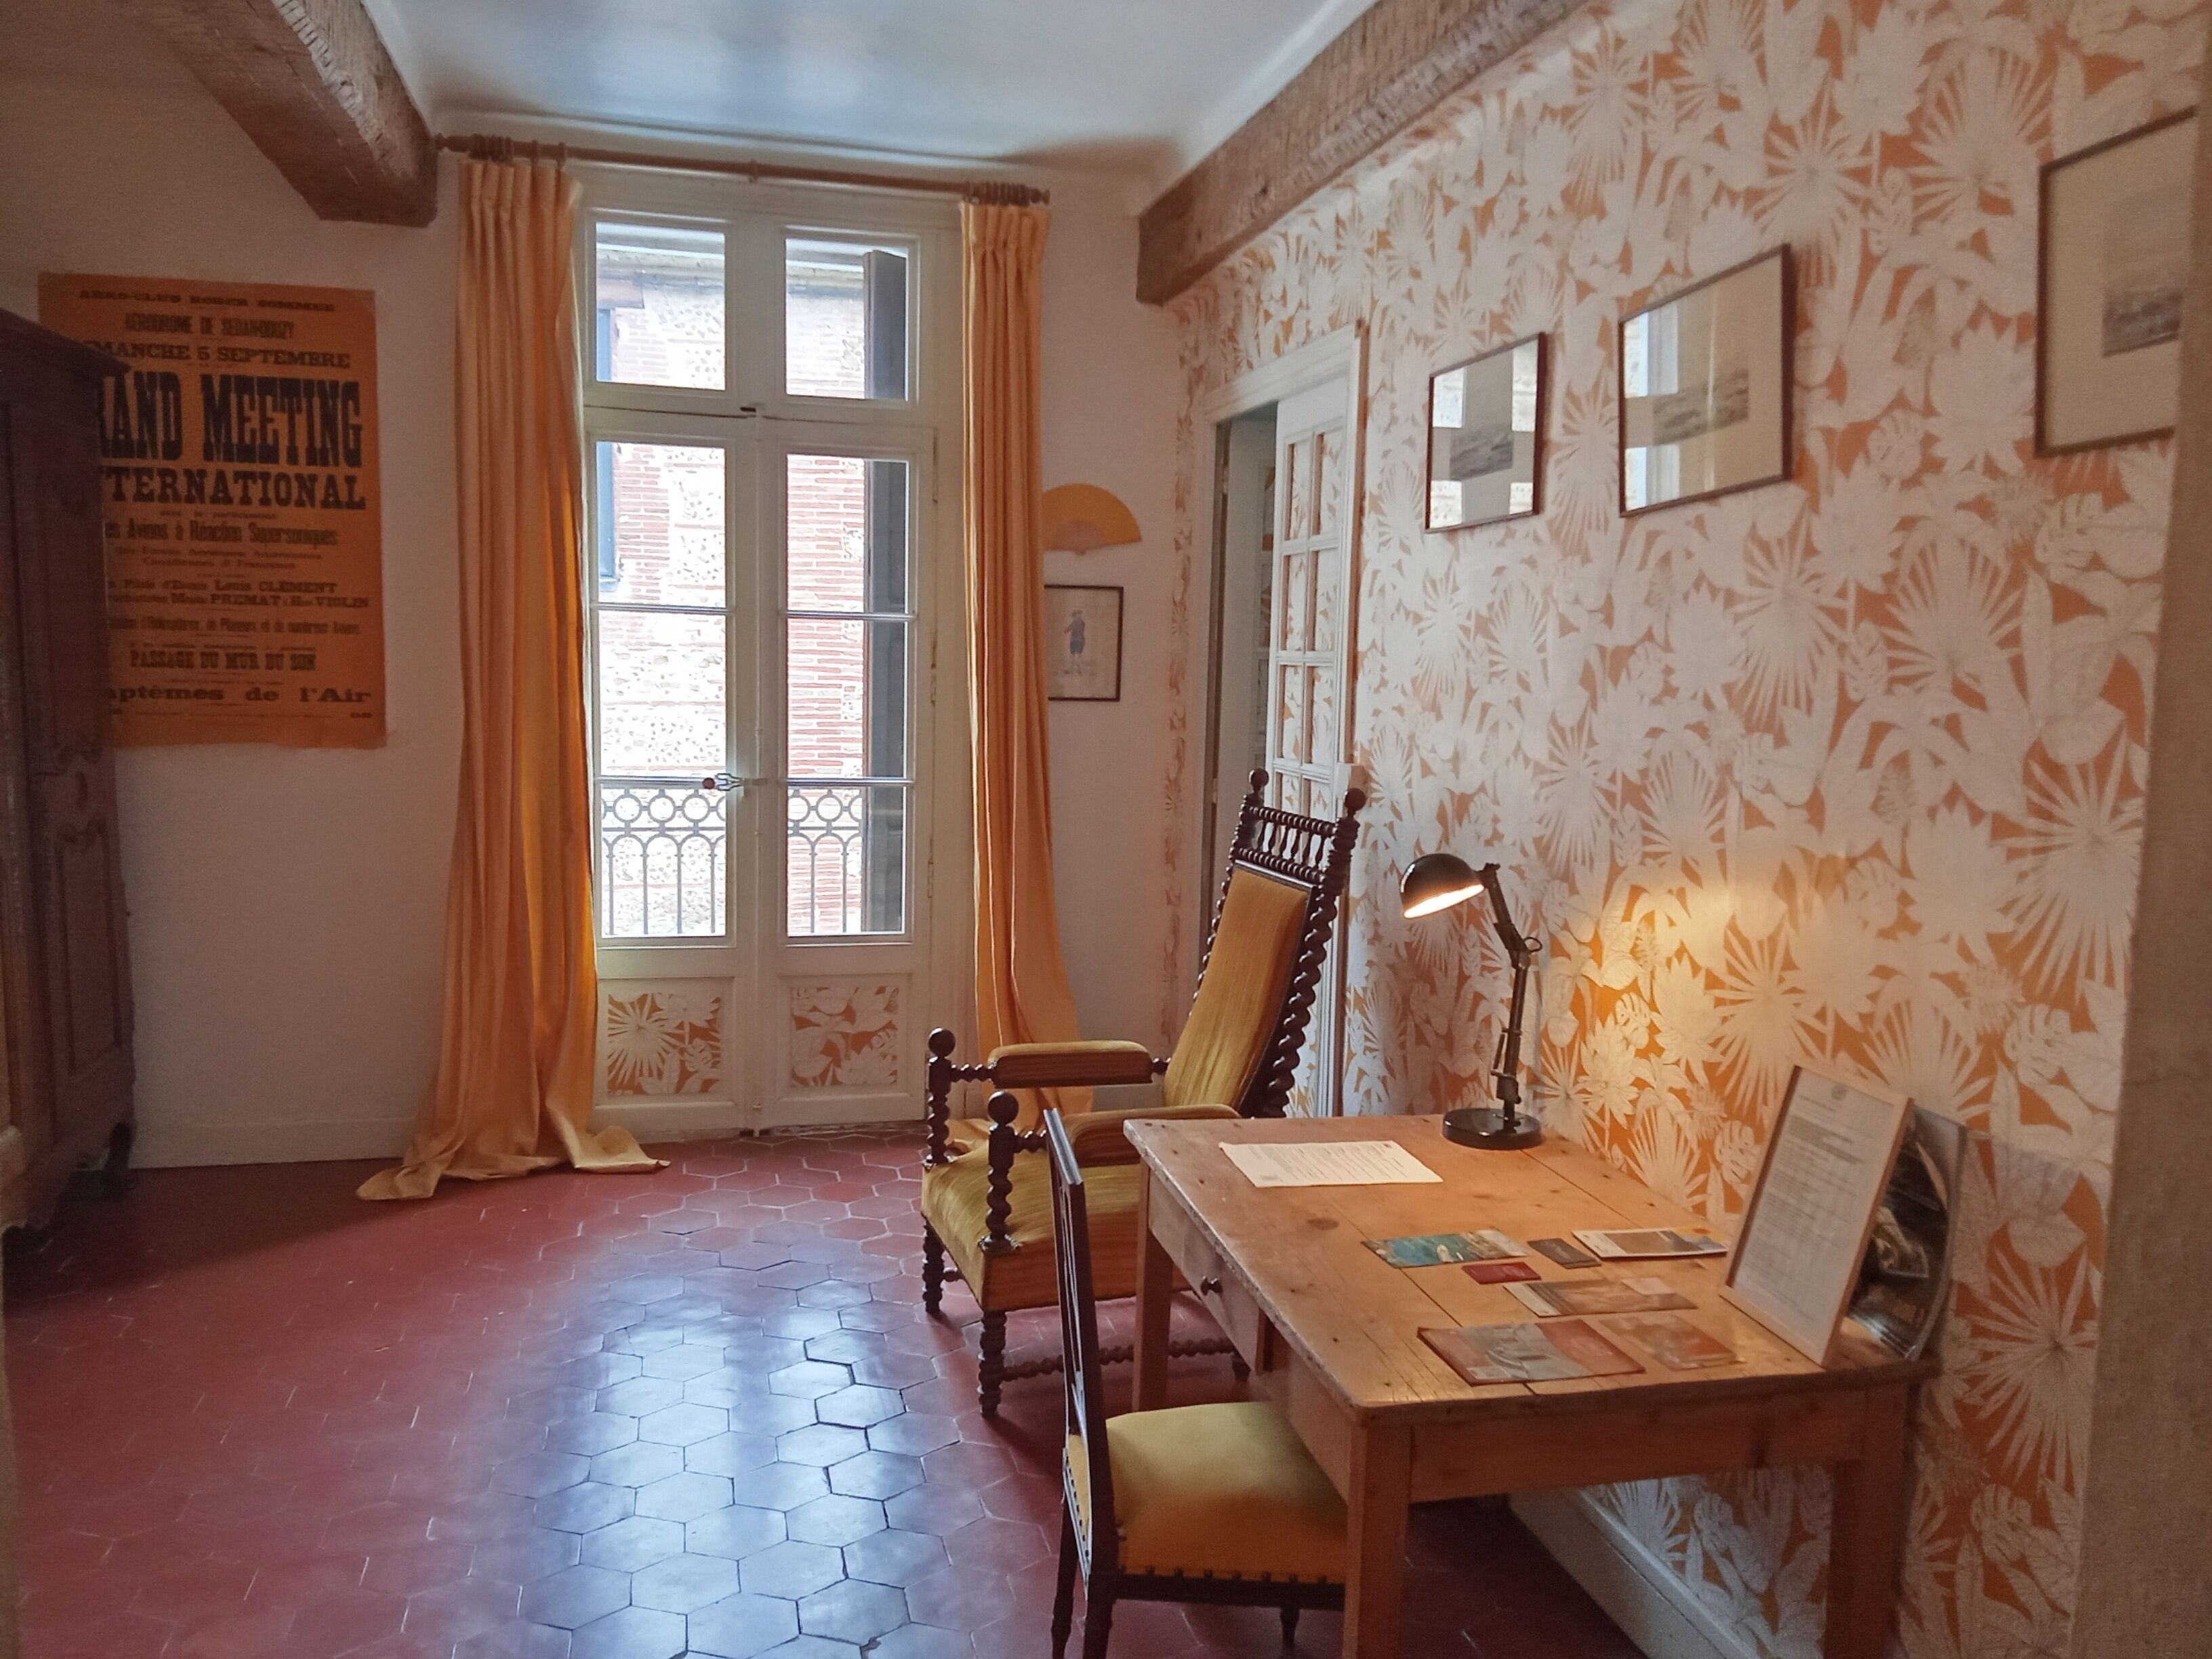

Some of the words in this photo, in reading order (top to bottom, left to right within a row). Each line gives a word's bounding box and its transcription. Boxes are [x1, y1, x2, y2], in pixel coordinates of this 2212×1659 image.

[82, 340, 192, 360] MANCHE
[197, 345, 211, 361] 5
[217, 346, 351, 369] SEPTEMBRE
[201, 373, 363, 469] MEETING
[103, 466, 366, 510] TERNATIONAL
[130, 650, 194, 668] PASSAGE
[200, 651, 220, 670] DU
[225, 653, 260, 670] MUR
[265, 653, 284, 671] DU
[245, 687, 279, 702] de
[300, 687, 371, 703] l'Air
